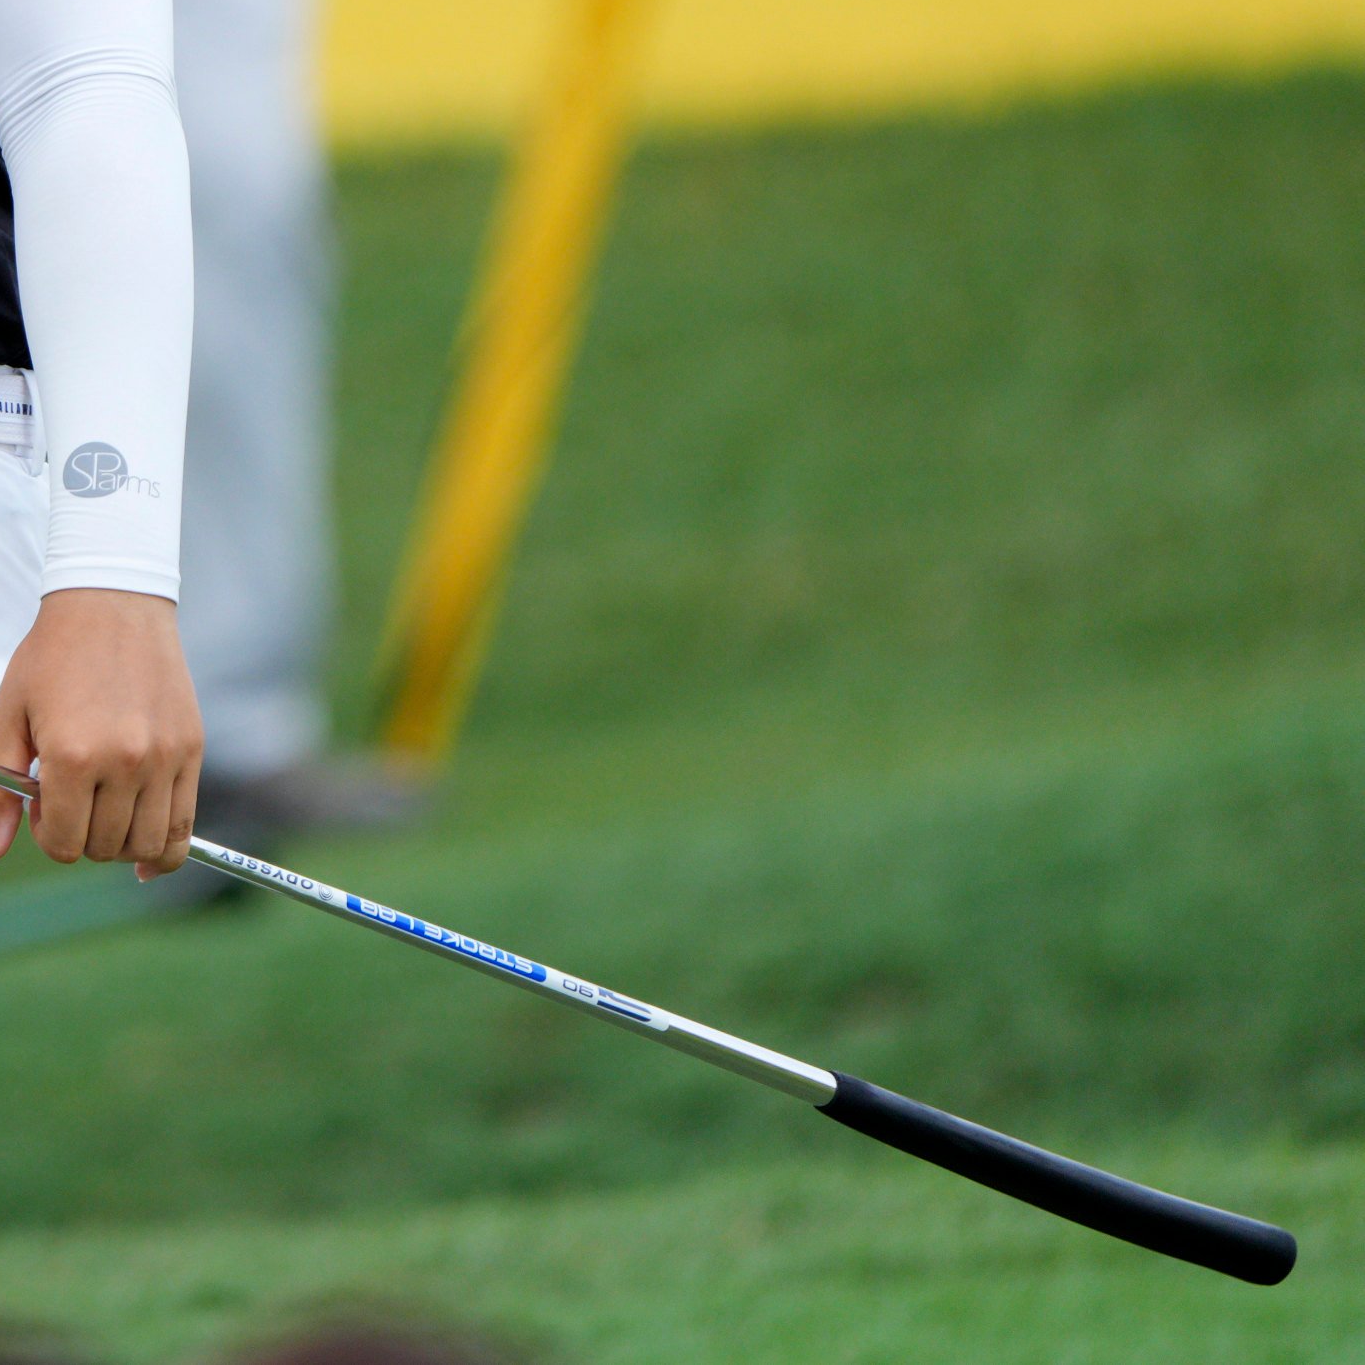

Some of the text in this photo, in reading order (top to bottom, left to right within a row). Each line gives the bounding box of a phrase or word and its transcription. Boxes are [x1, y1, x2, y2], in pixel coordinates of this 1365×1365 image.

[219, 849, 314, 891] ODYSSEY
[424, 923, 534, 974] STROKE
[562, 978, 594, 999] 90
